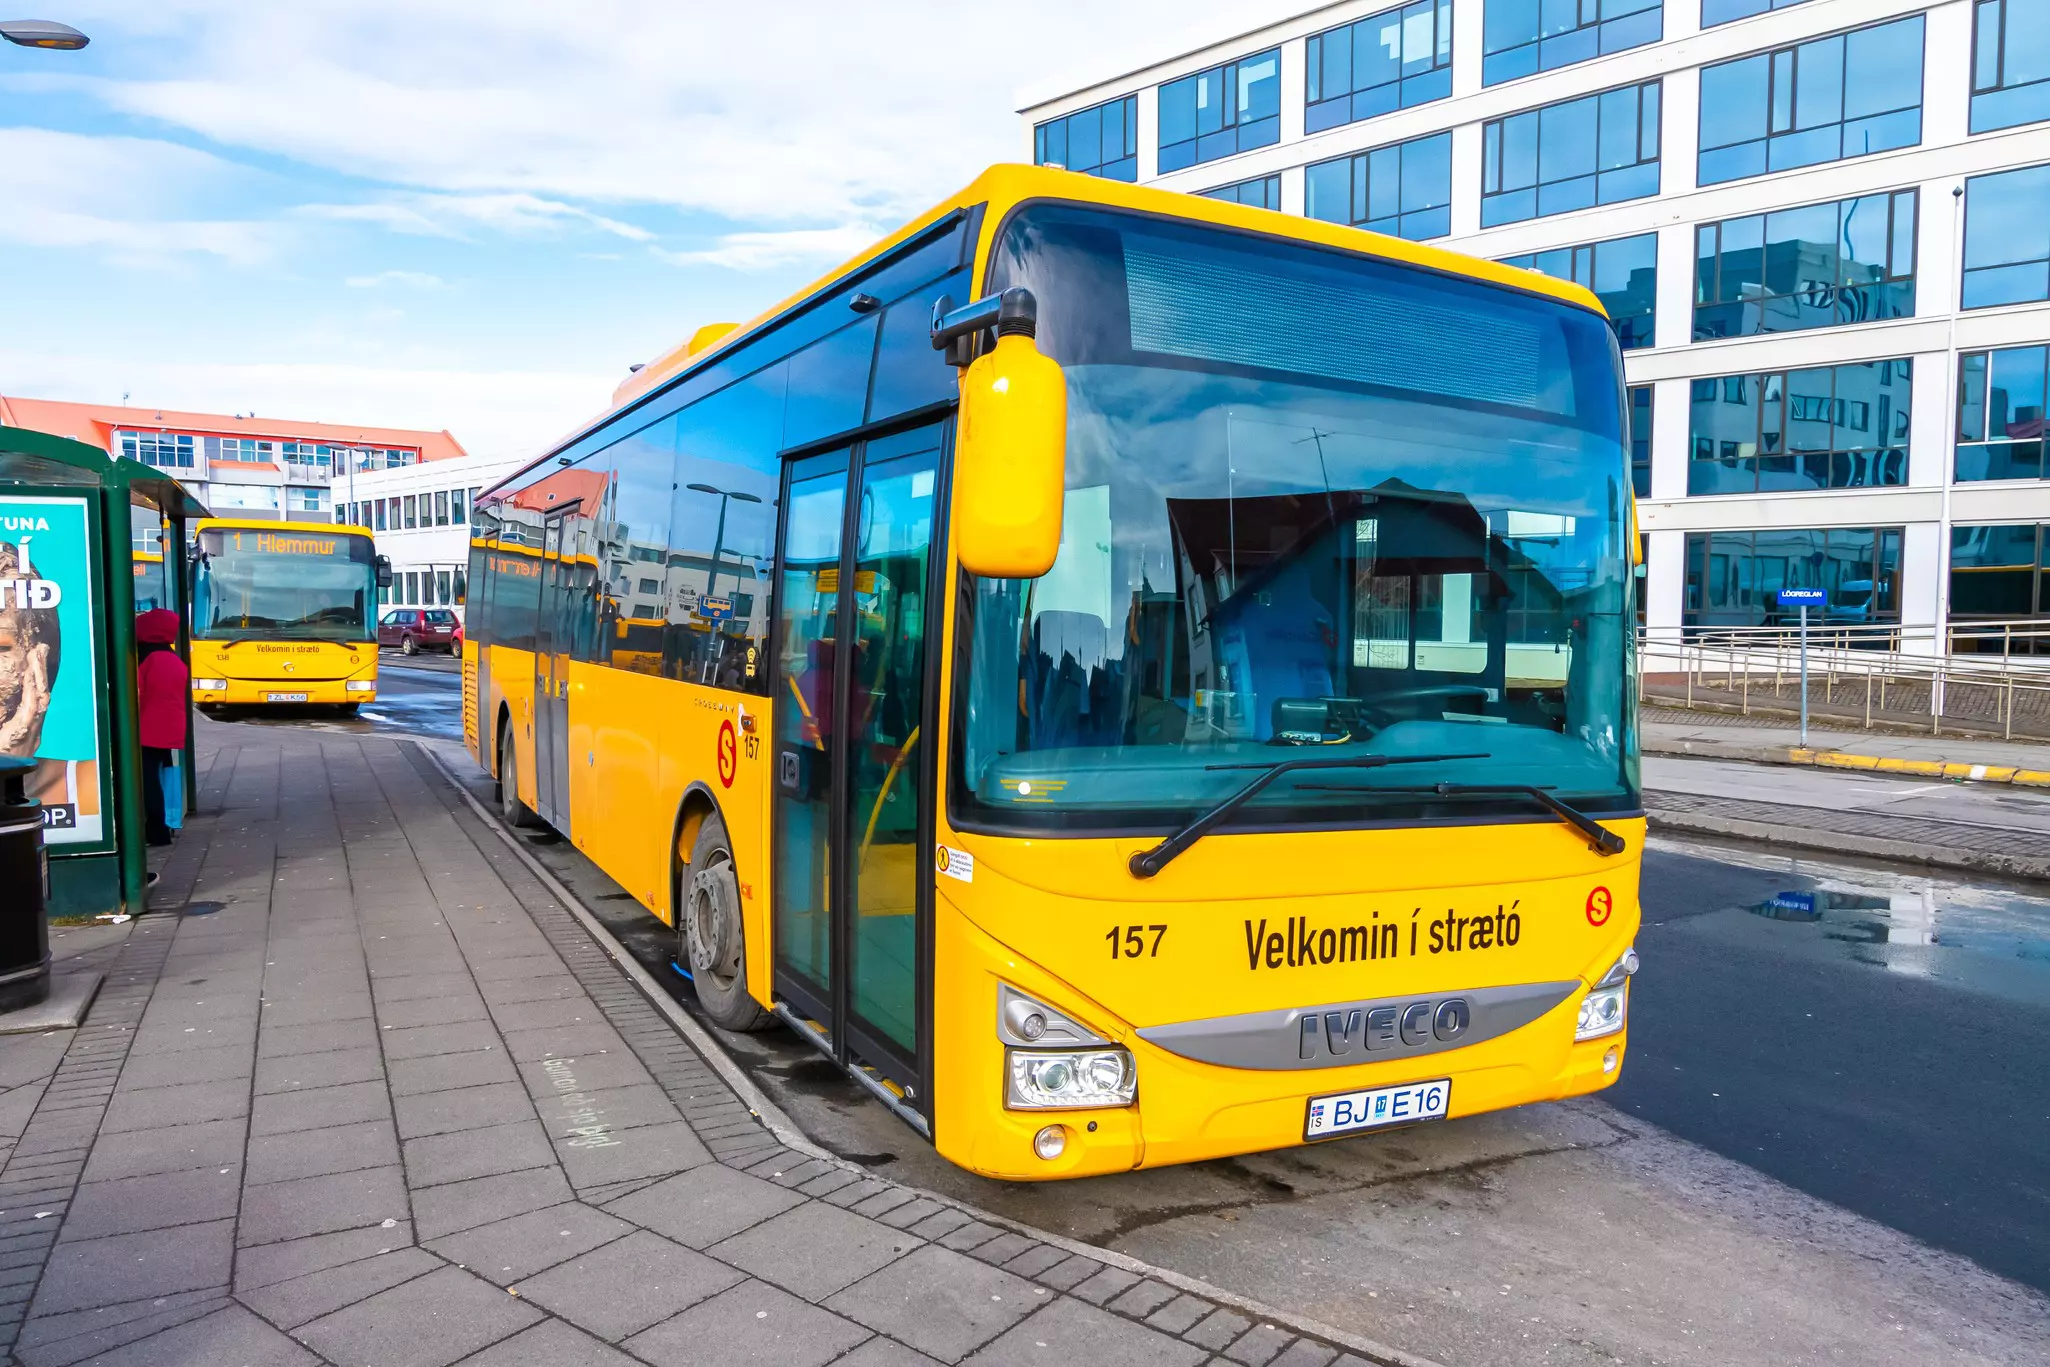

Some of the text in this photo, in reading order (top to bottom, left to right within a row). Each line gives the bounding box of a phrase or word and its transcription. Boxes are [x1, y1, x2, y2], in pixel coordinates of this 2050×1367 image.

[0, 517, 50, 531] UNA
[233, 532, 336, 555] 1 Hlemmur
[256, 644, 290, 653] Velkomin
[744, 734, 760, 761] 157
[1105, 924, 1168, 960] 157
[1244, 899, 1521, 970] Velkomin í strætó
[1299, 997, 1471, 1060] IVECO
[1333, 1096, 1371, 1126] BJ
[1391, 1087, 1441, 1118] E16
[1311, 1117, 1322, 1128] IS
